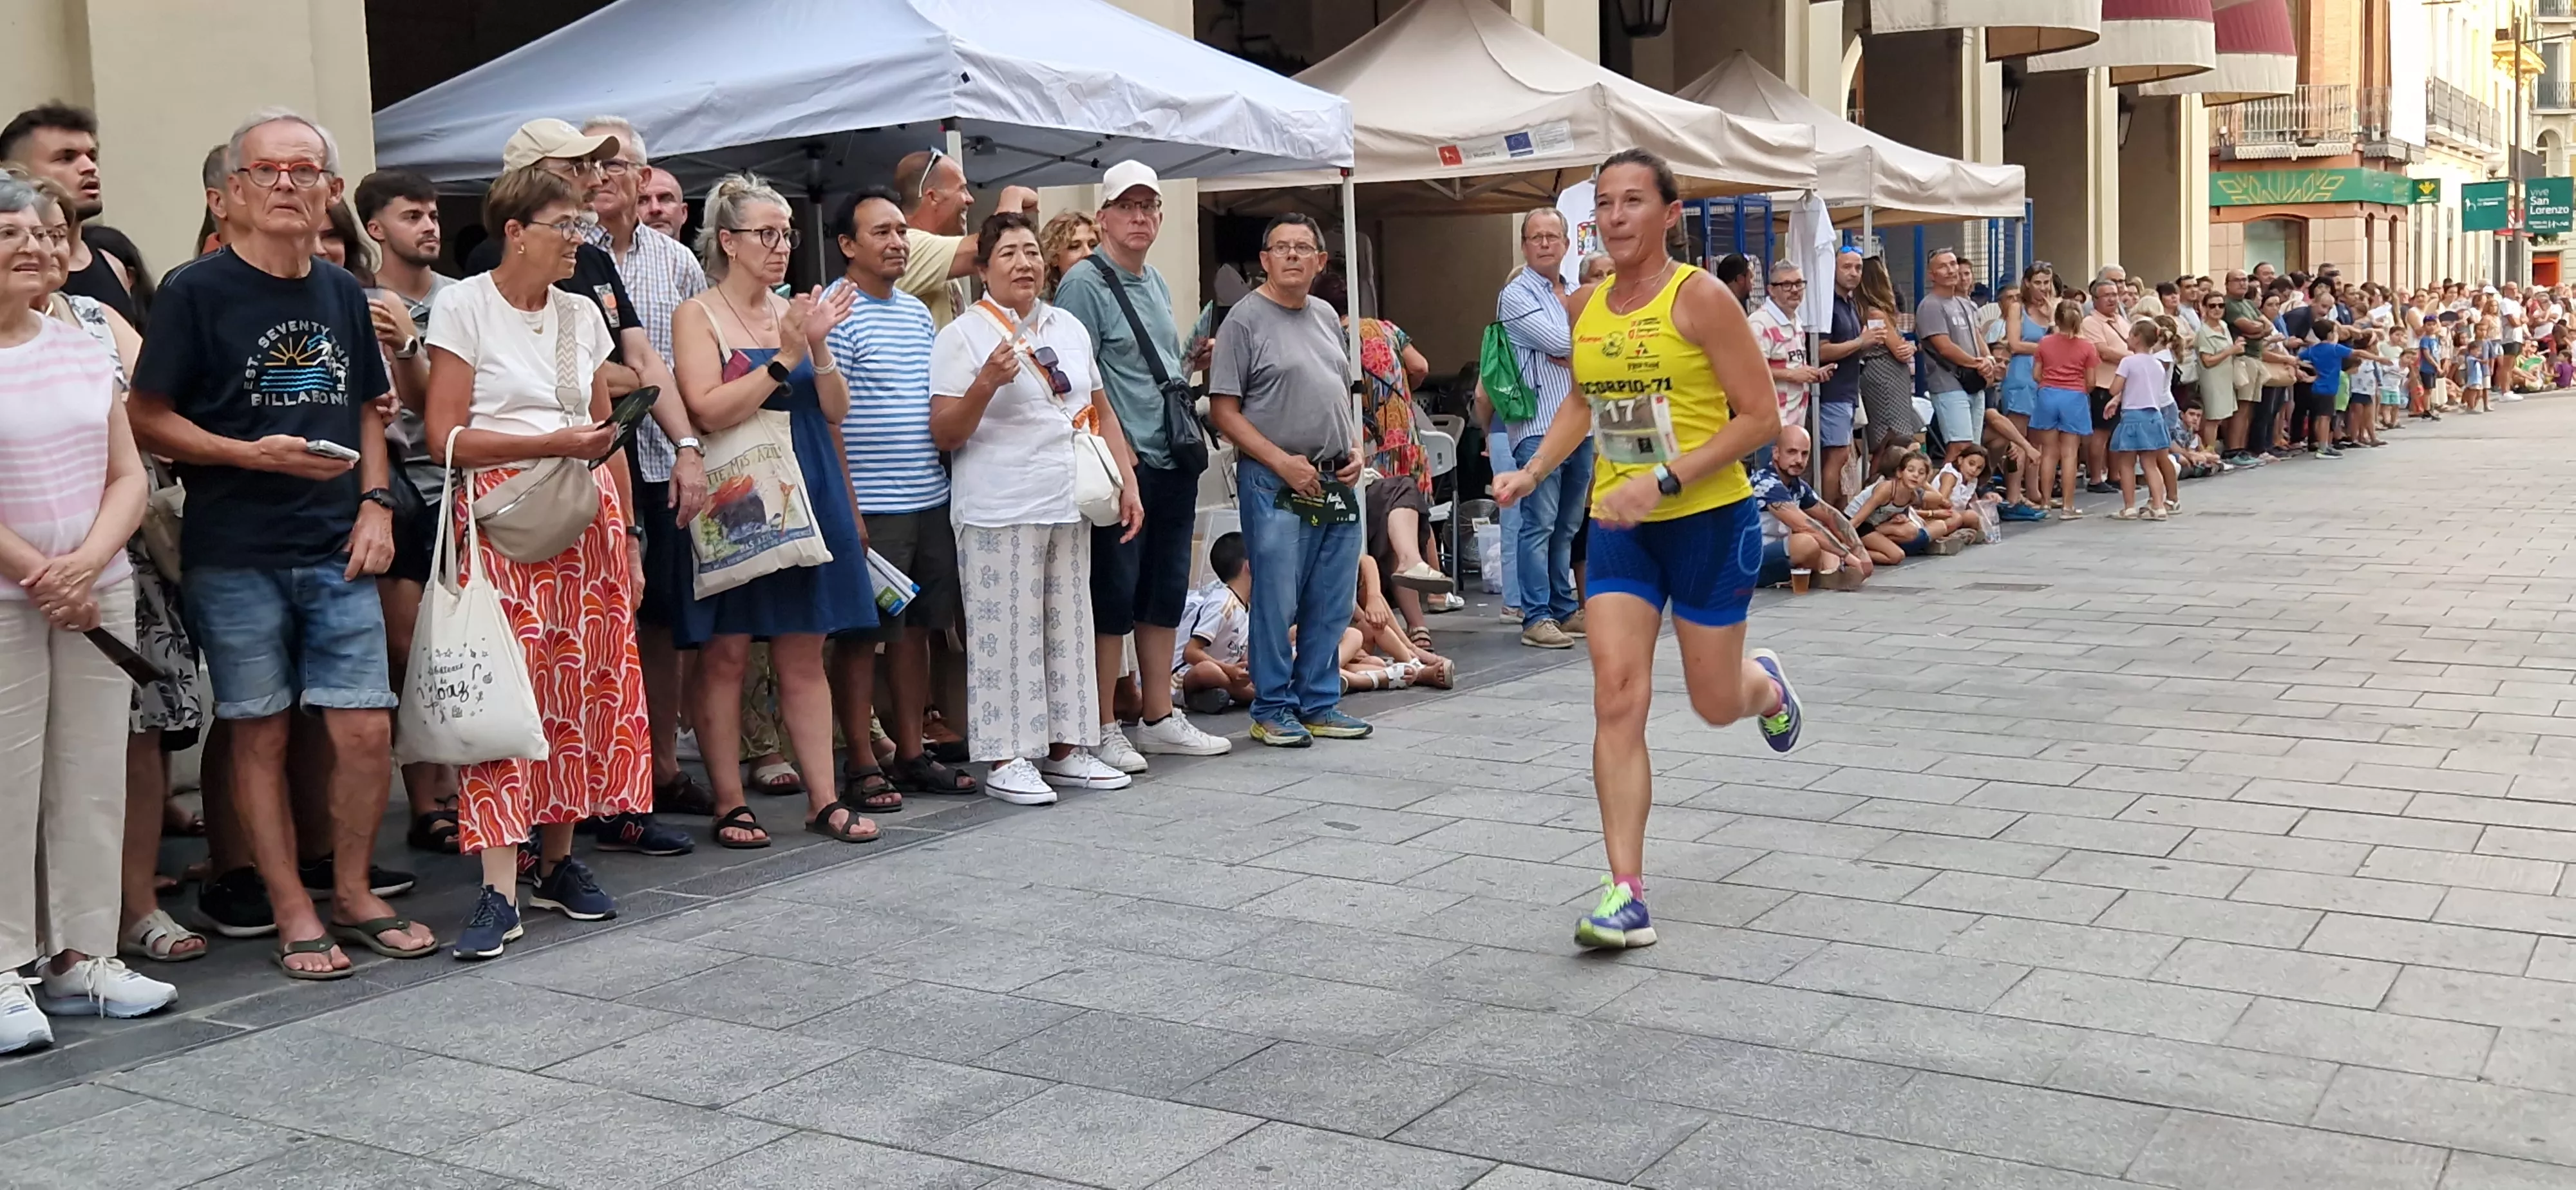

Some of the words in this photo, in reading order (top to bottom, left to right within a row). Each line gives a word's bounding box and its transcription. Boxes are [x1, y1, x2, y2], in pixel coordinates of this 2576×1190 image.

[2530, 196, 2550, 205] San
[2530, 206, 2570, 214] Lorenzo
[243, 355, 261, 390] EST.
[258, 320, 330, 348] SEVENTY
[621, 821, 644, 844] N
